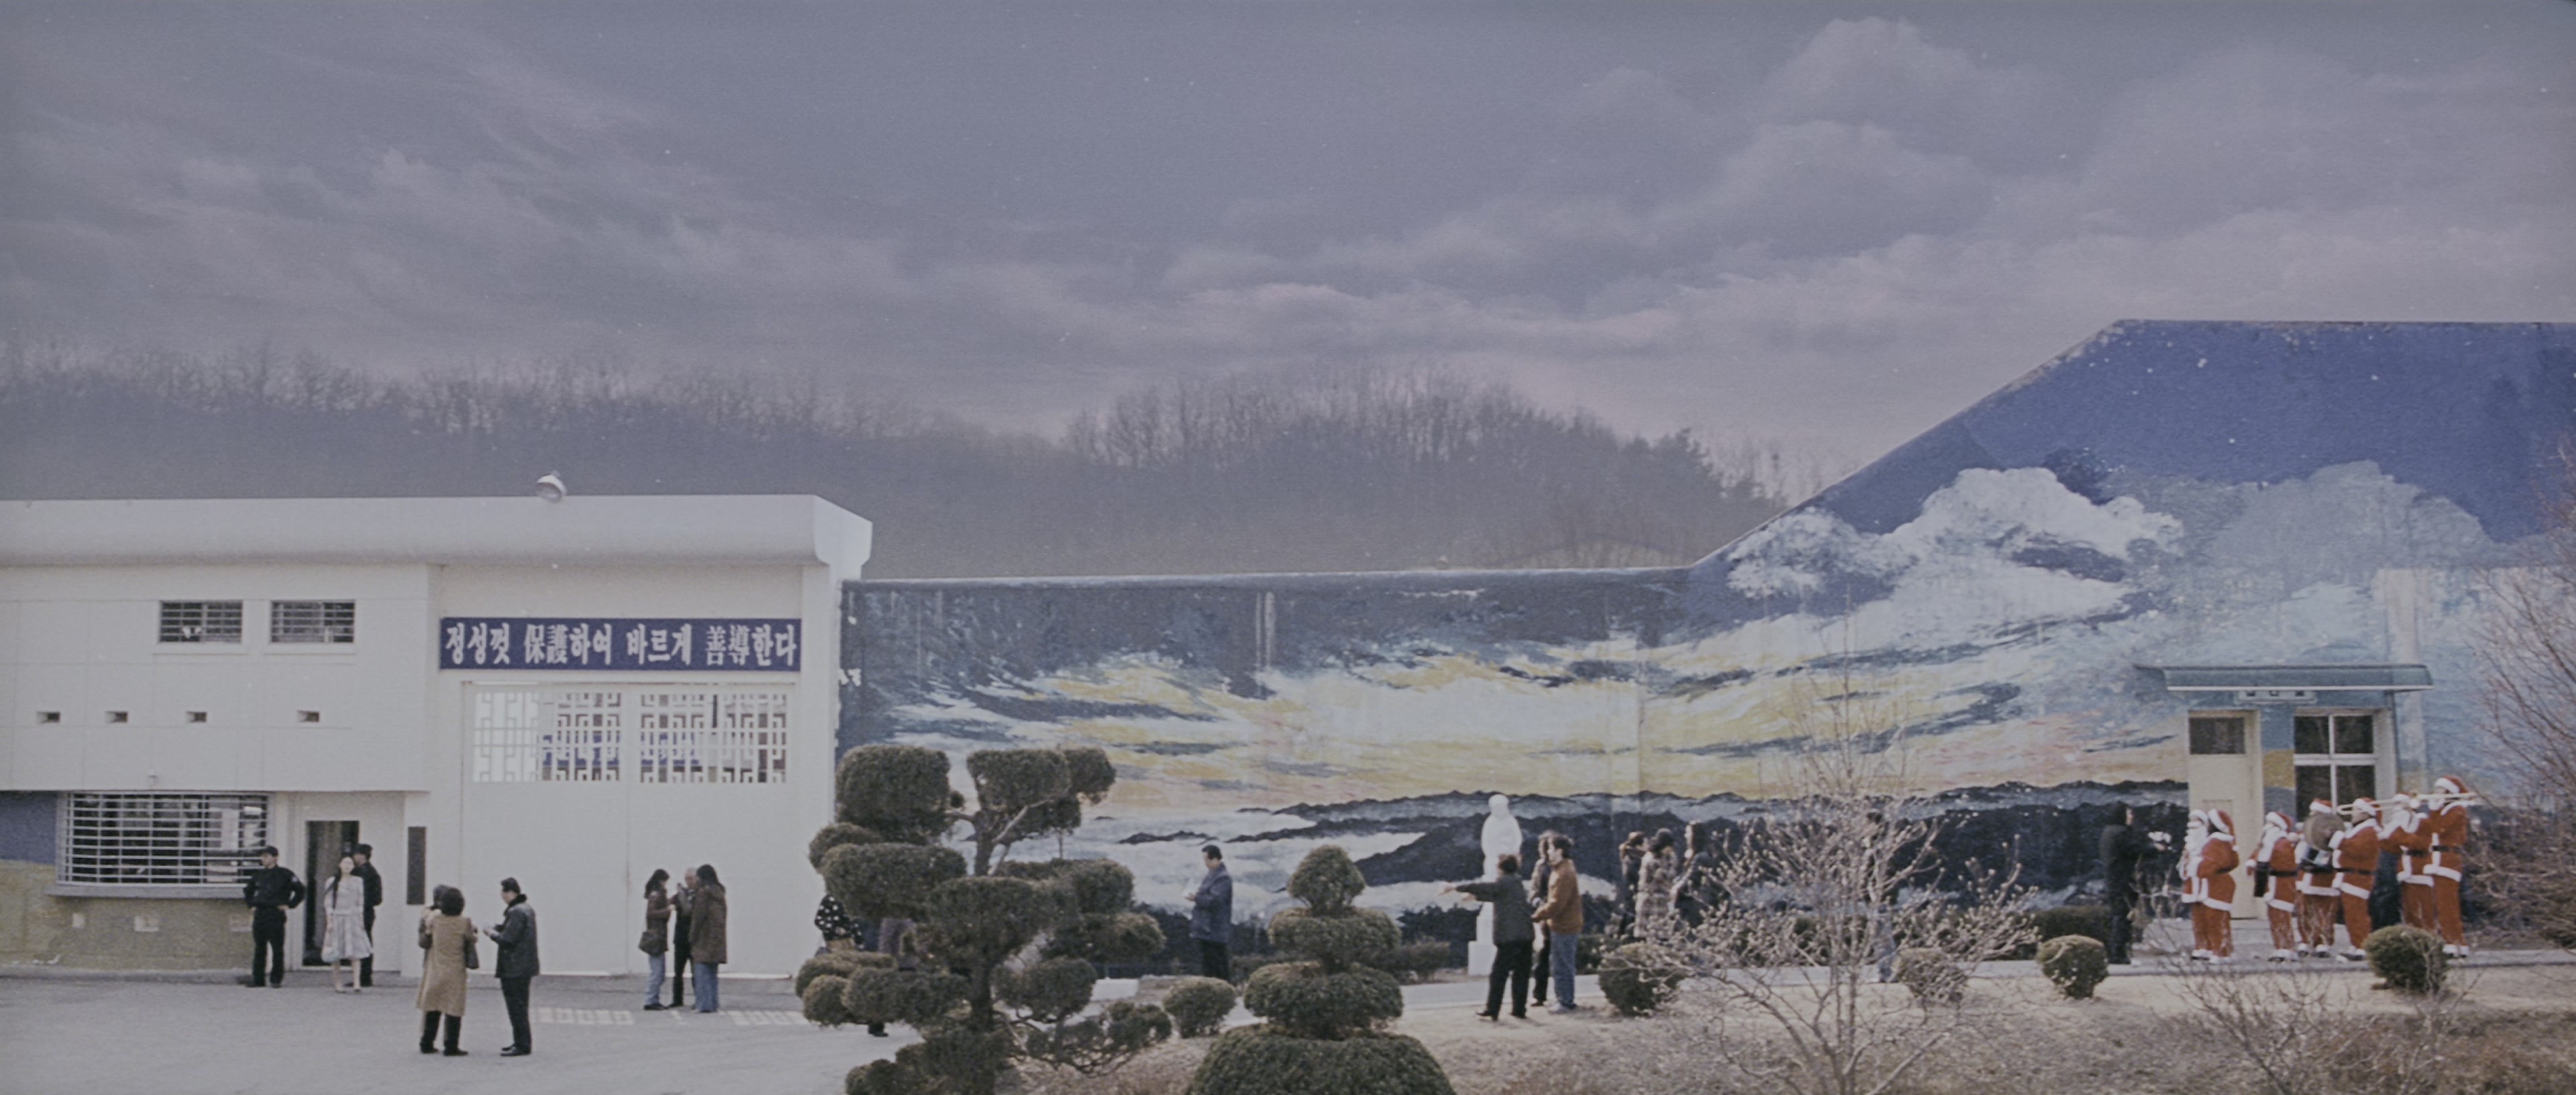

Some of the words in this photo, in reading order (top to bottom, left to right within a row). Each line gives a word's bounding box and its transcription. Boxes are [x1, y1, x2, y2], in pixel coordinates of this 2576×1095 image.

[446, 623, 510, 665] 정성껏
[524, 623, 612, 666] 保護하여
[626, 623, 692, 666] 바르게
[706, 624, 797, 666] 善導한다
